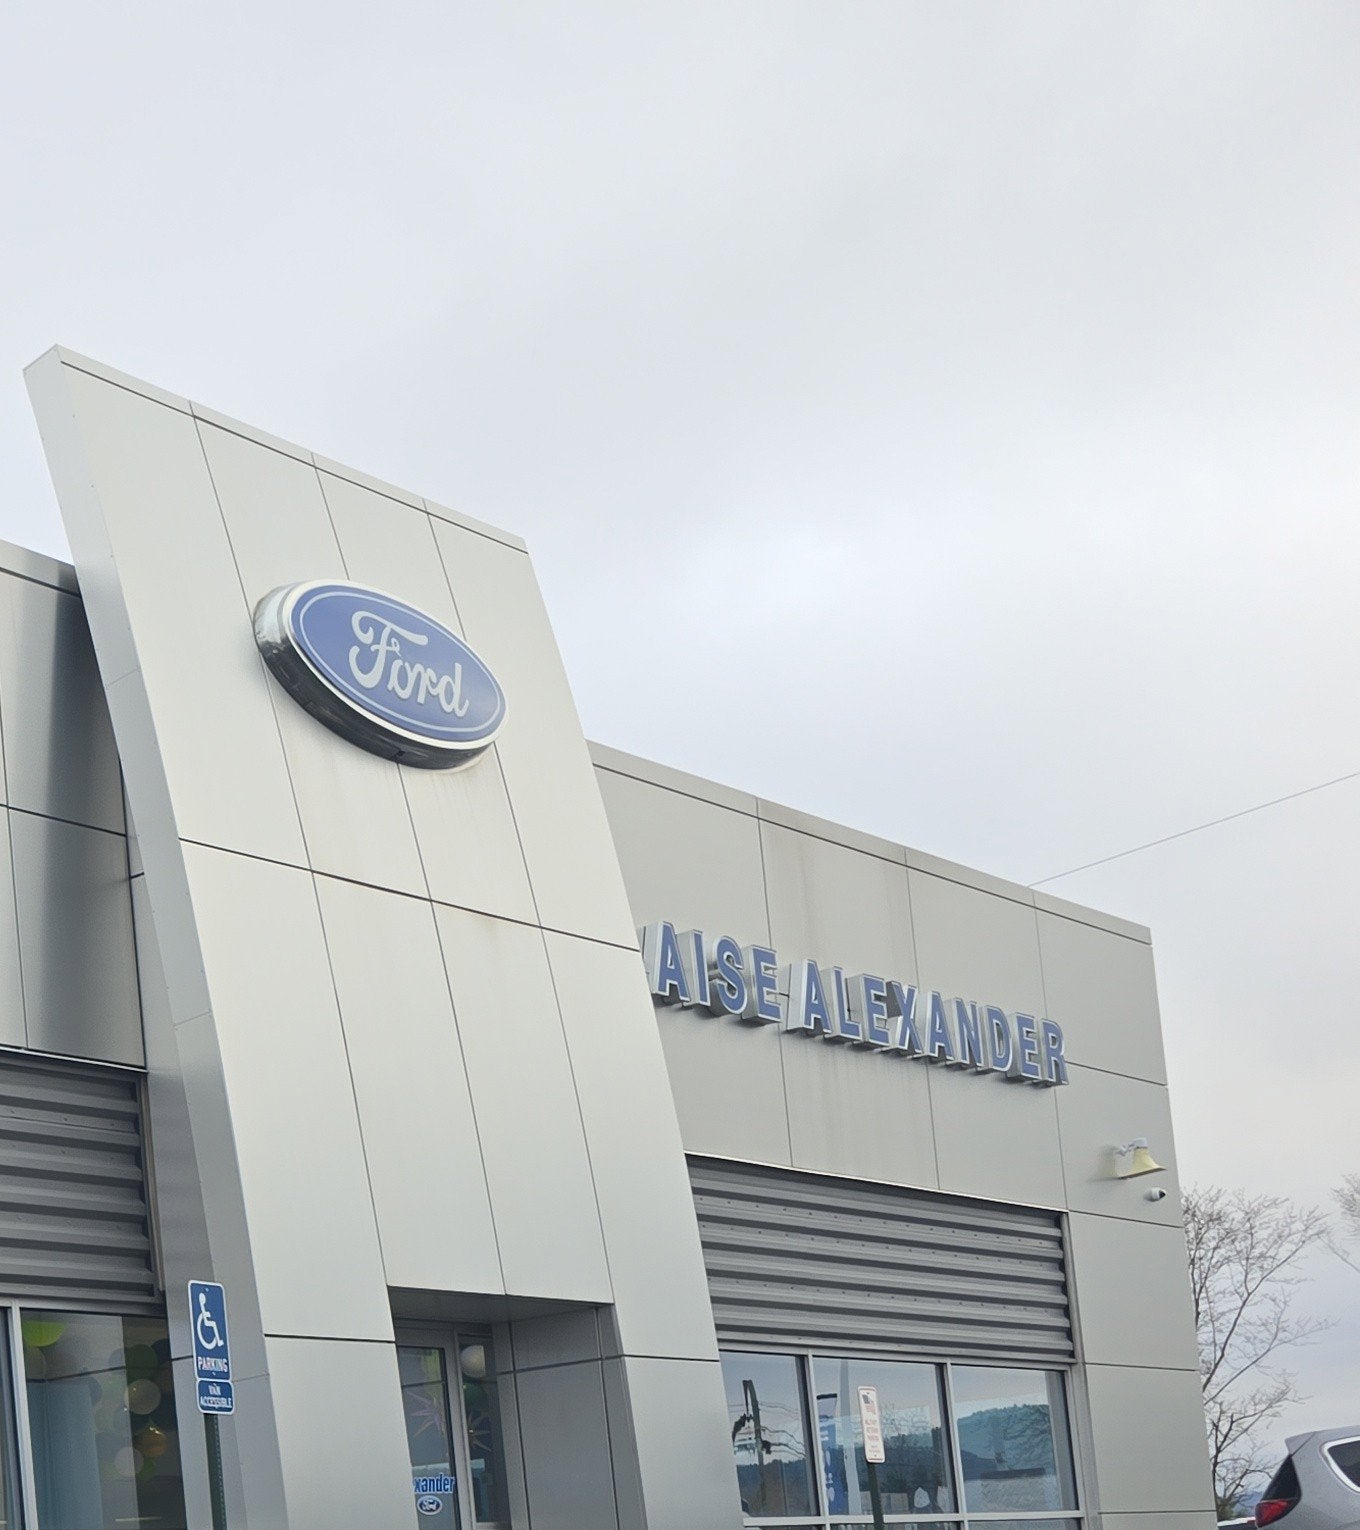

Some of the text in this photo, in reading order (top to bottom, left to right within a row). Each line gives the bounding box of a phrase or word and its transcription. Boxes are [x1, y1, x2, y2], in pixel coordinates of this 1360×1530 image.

[348, 610, 470, 718] Ford
[652, 920, 1069, 1085] AISE ALEXANDER
[198, 1357, 229, 1372] PARKING
[414, 1473, 454, 1493] xander
